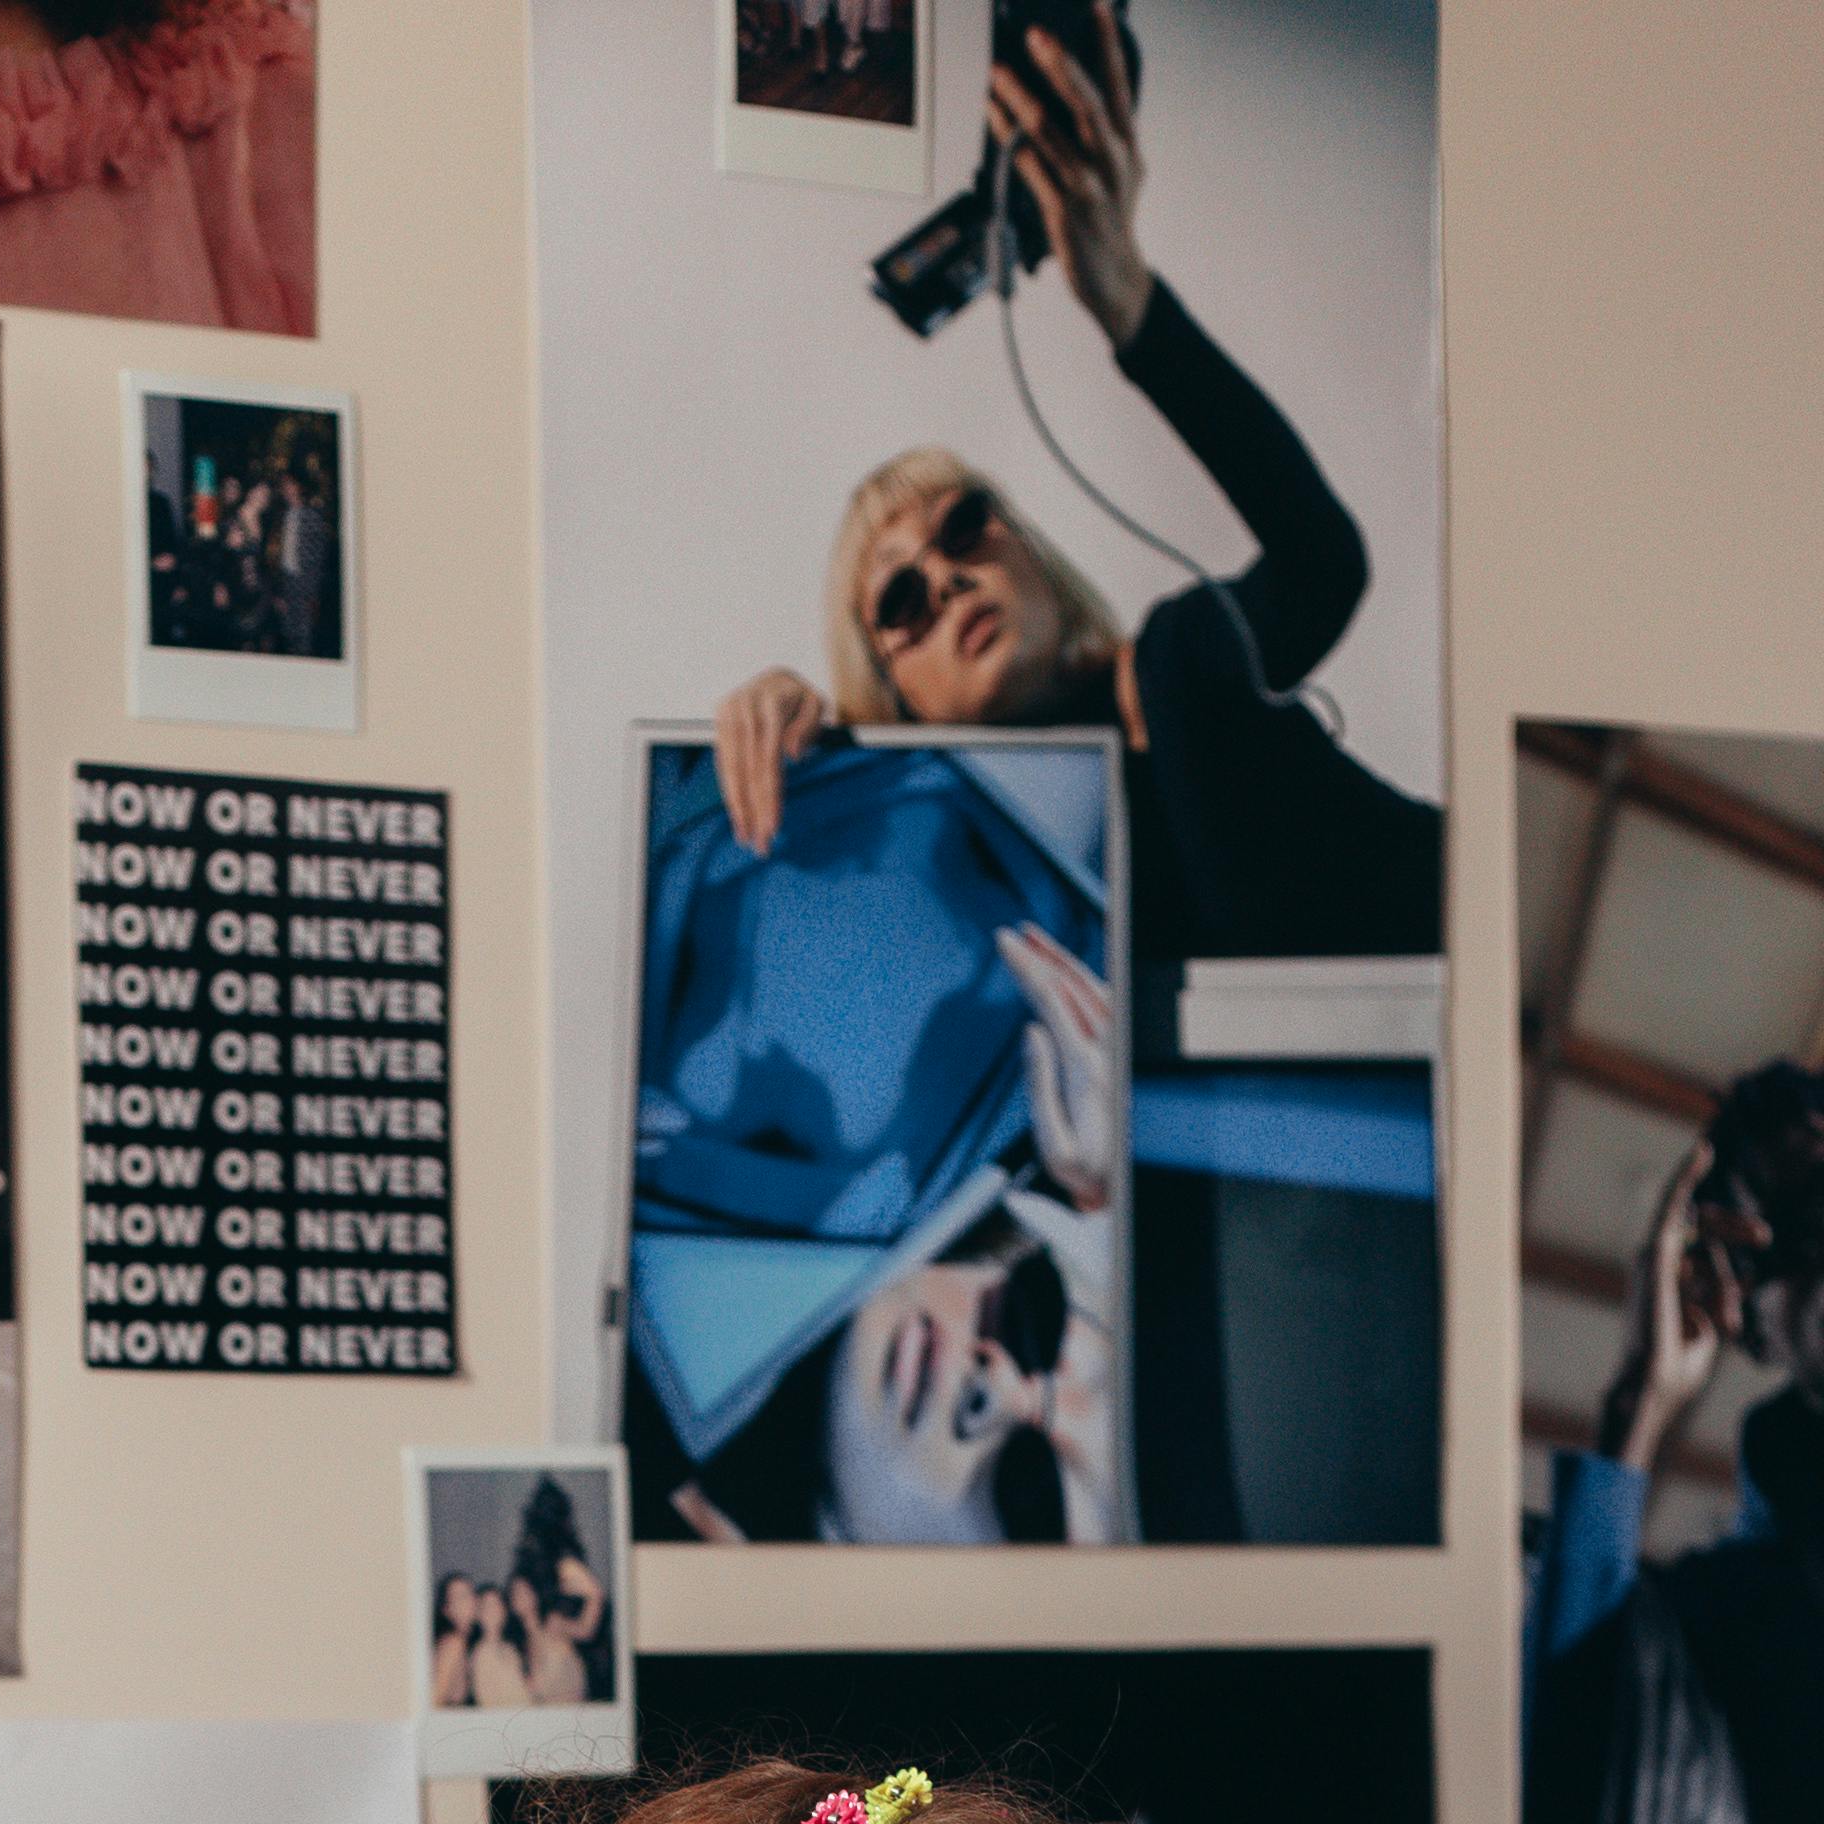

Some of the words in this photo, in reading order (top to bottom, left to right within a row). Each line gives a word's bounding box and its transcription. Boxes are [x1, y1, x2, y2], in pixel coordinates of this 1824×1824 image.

[77, 778, 196, 831] NOW
[205, 789, 277, 836] OR
[287, 795, 443, 848] NEVER
[77, 841, 197, 890] NOW
[206, 849, 277, 896] OR
[288, 855, 443, 907] NEVER
[77, 902, 197, 950] NOW
[207, 910, 278, 957] OR
[289, 915, 443, 967] NEVER
[78, 962, 200, 1011] NOW
[209, 969, 280, 1016] OR
[291, 975, 444, 1024] NEVER
[80, 1023, 200, 1070] NOW
[210, 1030, 281, 1075] OR
[292, 1035, 444, 1083] NEVER
[84, 1082, 202, 1130] NOW
[212, 1089, 282, 1135] OR
[294, 1093, 444, 1142] NEVER
[85, 1143, 203, 1189] NOW
[213, 1148, 284, 1192] OR
[295, 1152, 445, 1199] NEVER
[87, 1203, 205, 1247] NOW
[215, 1206, 285, 1250] OR
[296, 1210, 446, 1255] NEVER
[88, 1262, 207, 1307] NOW
[216, 1264, 286, 1308] OR
[297, 1267, 448, 1313] NEVER
[88, 1320, 208, 1364] NOW
[218, 1322, 287, 1366] OR
[299, 1325, 450, 1369] NEVER
